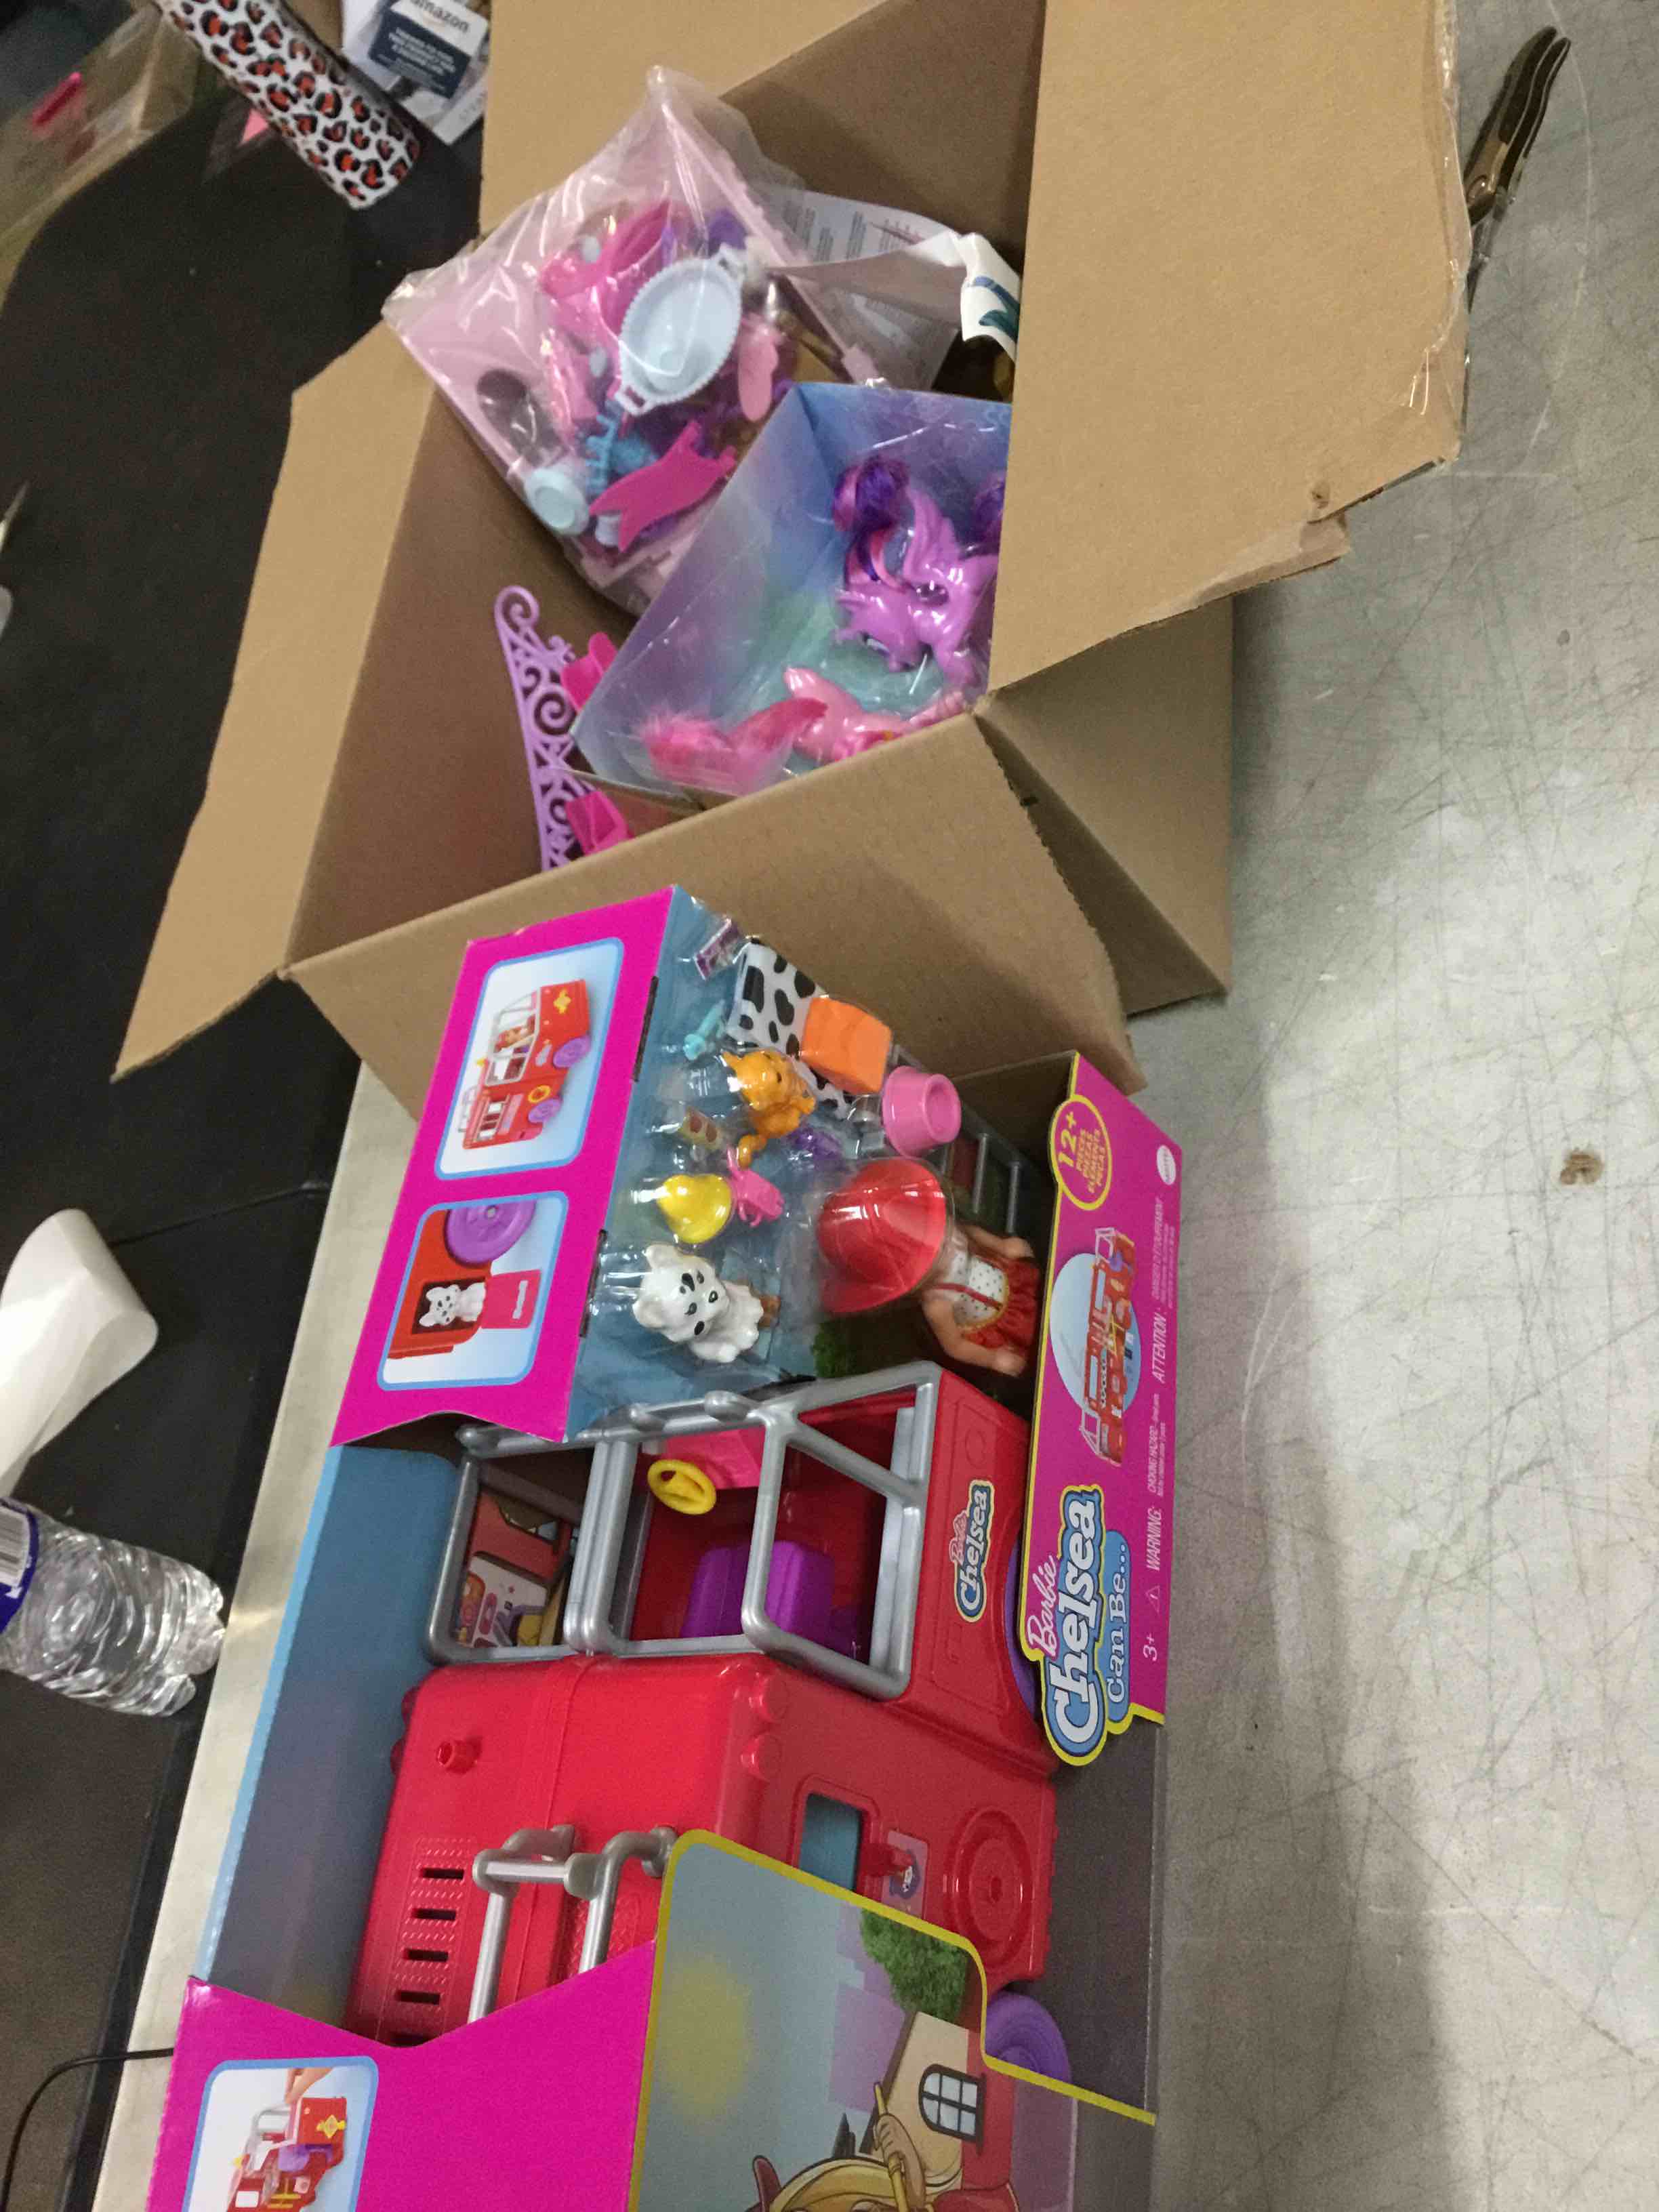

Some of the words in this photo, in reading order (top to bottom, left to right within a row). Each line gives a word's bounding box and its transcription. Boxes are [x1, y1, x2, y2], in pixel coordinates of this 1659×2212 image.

[1058, 1111, 1076, 1167] 12+
[960, 1490, 986, 1610] Chelsea
[1109, 1544, 1127, 1622] Be...
[1027, 1555, 1057, 1656] Barbie
[1050, 1500, 1099, 1742] Chelsea
[1107, 1629, 1124, 1703] Can
[1143, 1633, 1158, 1661] 3+
